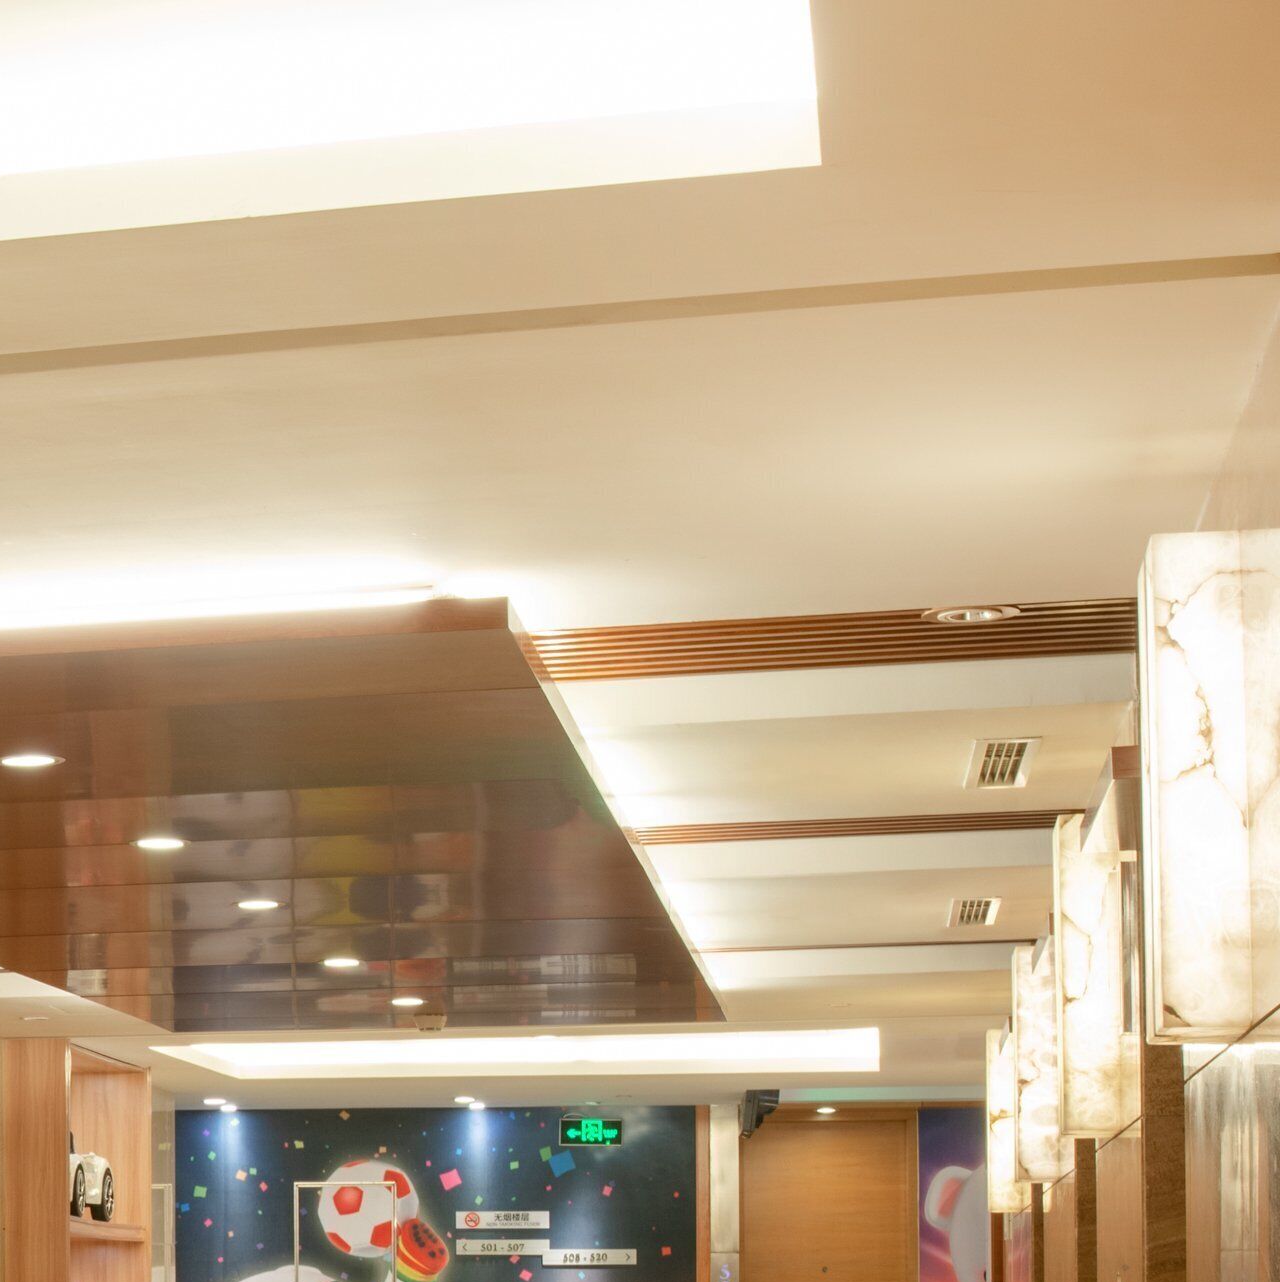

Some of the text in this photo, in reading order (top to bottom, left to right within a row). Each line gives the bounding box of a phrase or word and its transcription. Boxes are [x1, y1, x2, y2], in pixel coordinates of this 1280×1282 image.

[494, 1212, 530, 1222] 无烟楼层
[480, 1243, 498, 1252] 501
[507, 1243, 525, 1252] 507
